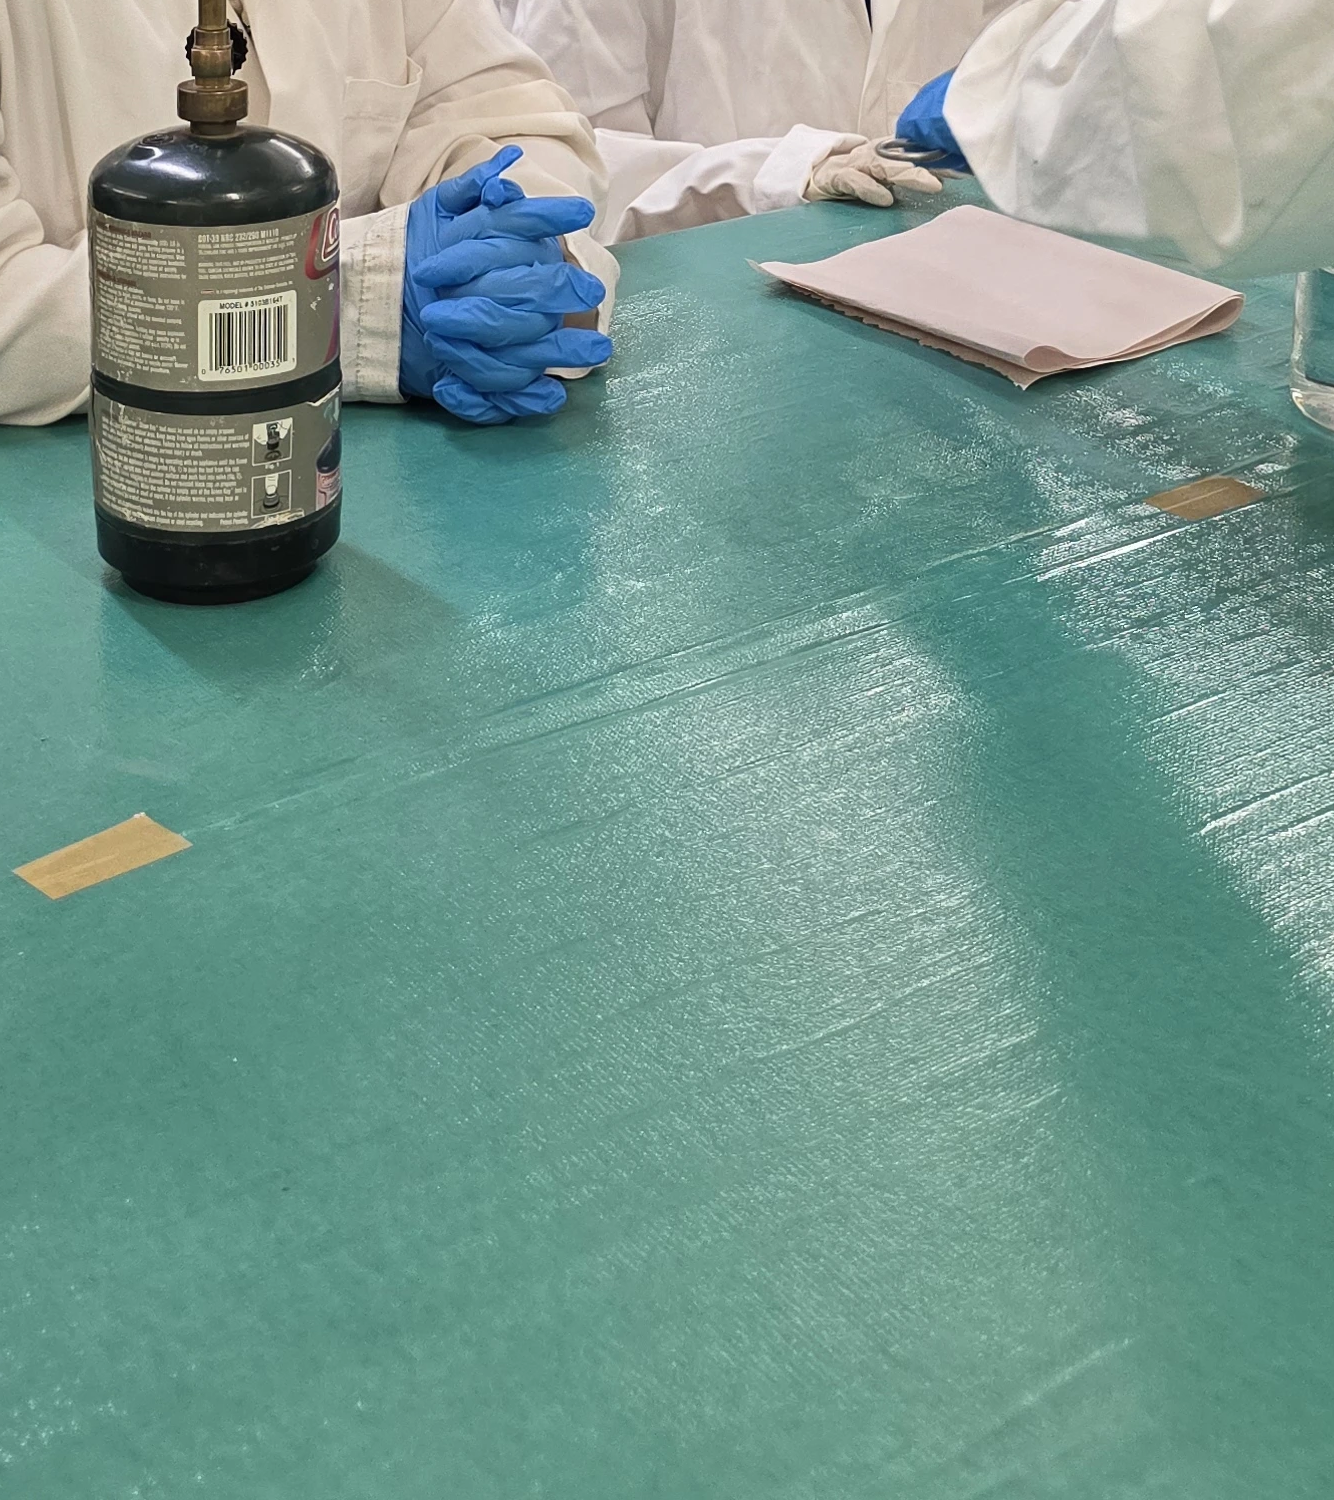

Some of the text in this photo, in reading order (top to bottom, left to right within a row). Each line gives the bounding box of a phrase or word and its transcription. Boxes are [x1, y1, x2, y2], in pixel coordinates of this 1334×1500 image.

[219, 301, 243, 310] MODEL
[219, 364, 248, 374] 76501
[253, 359, 281, 371] 00035
